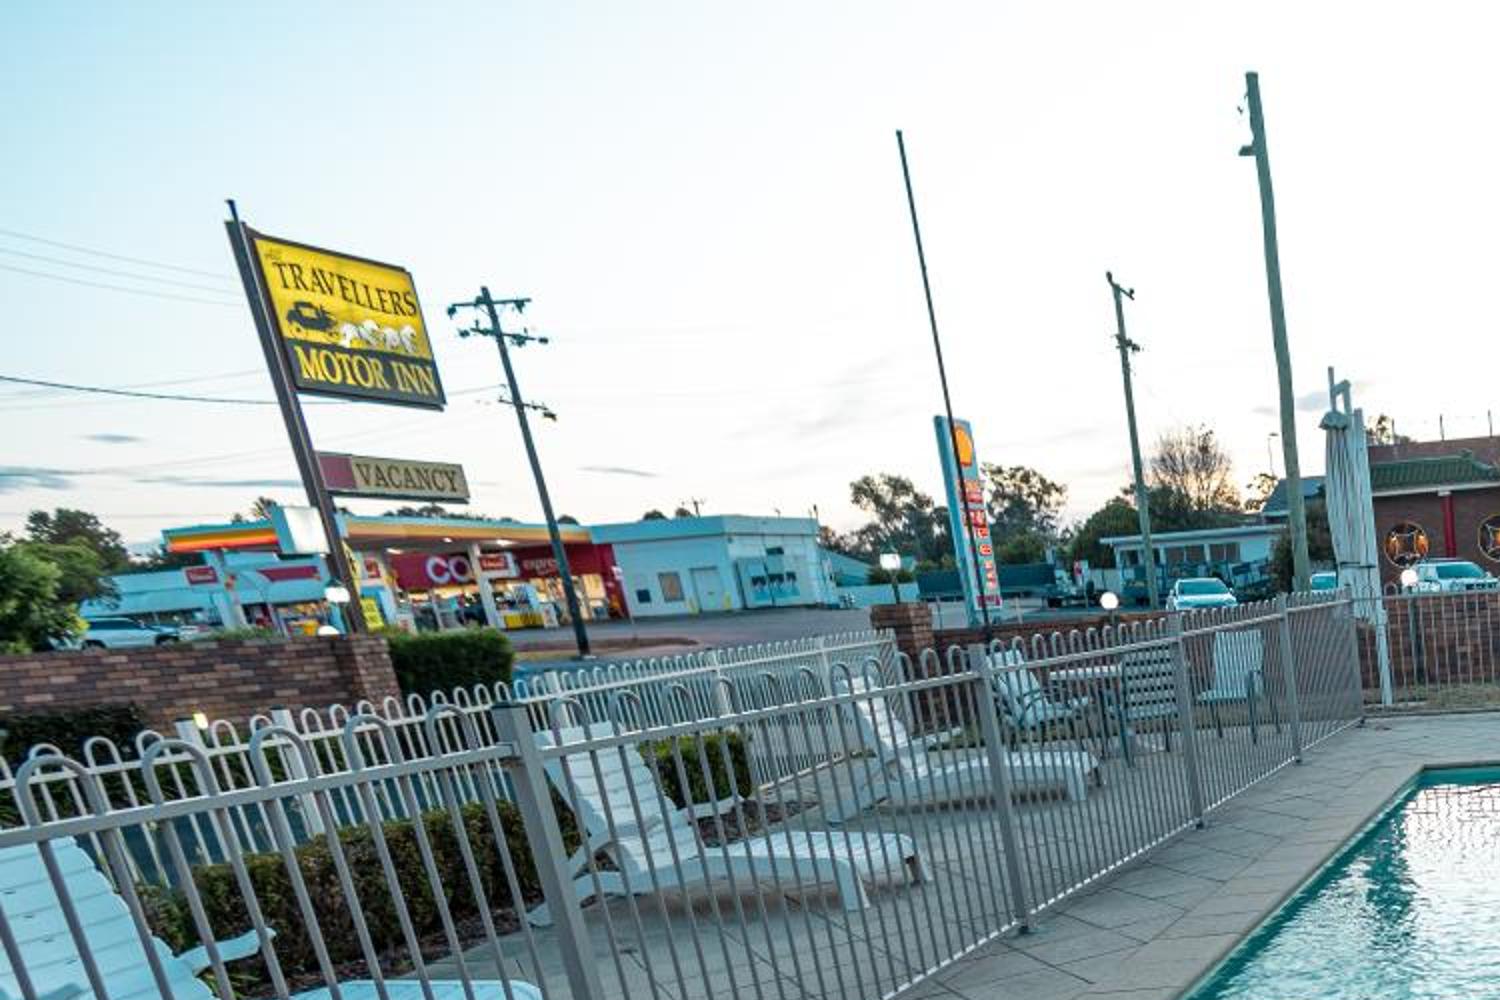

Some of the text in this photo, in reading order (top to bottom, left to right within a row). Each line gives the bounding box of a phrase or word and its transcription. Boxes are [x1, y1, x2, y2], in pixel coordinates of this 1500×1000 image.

[272, 261, 417, 316] TRAVELLERS
[294, 347, 438, 396] MOTOR INN
[355, 463, 457, 492] VACANCY
